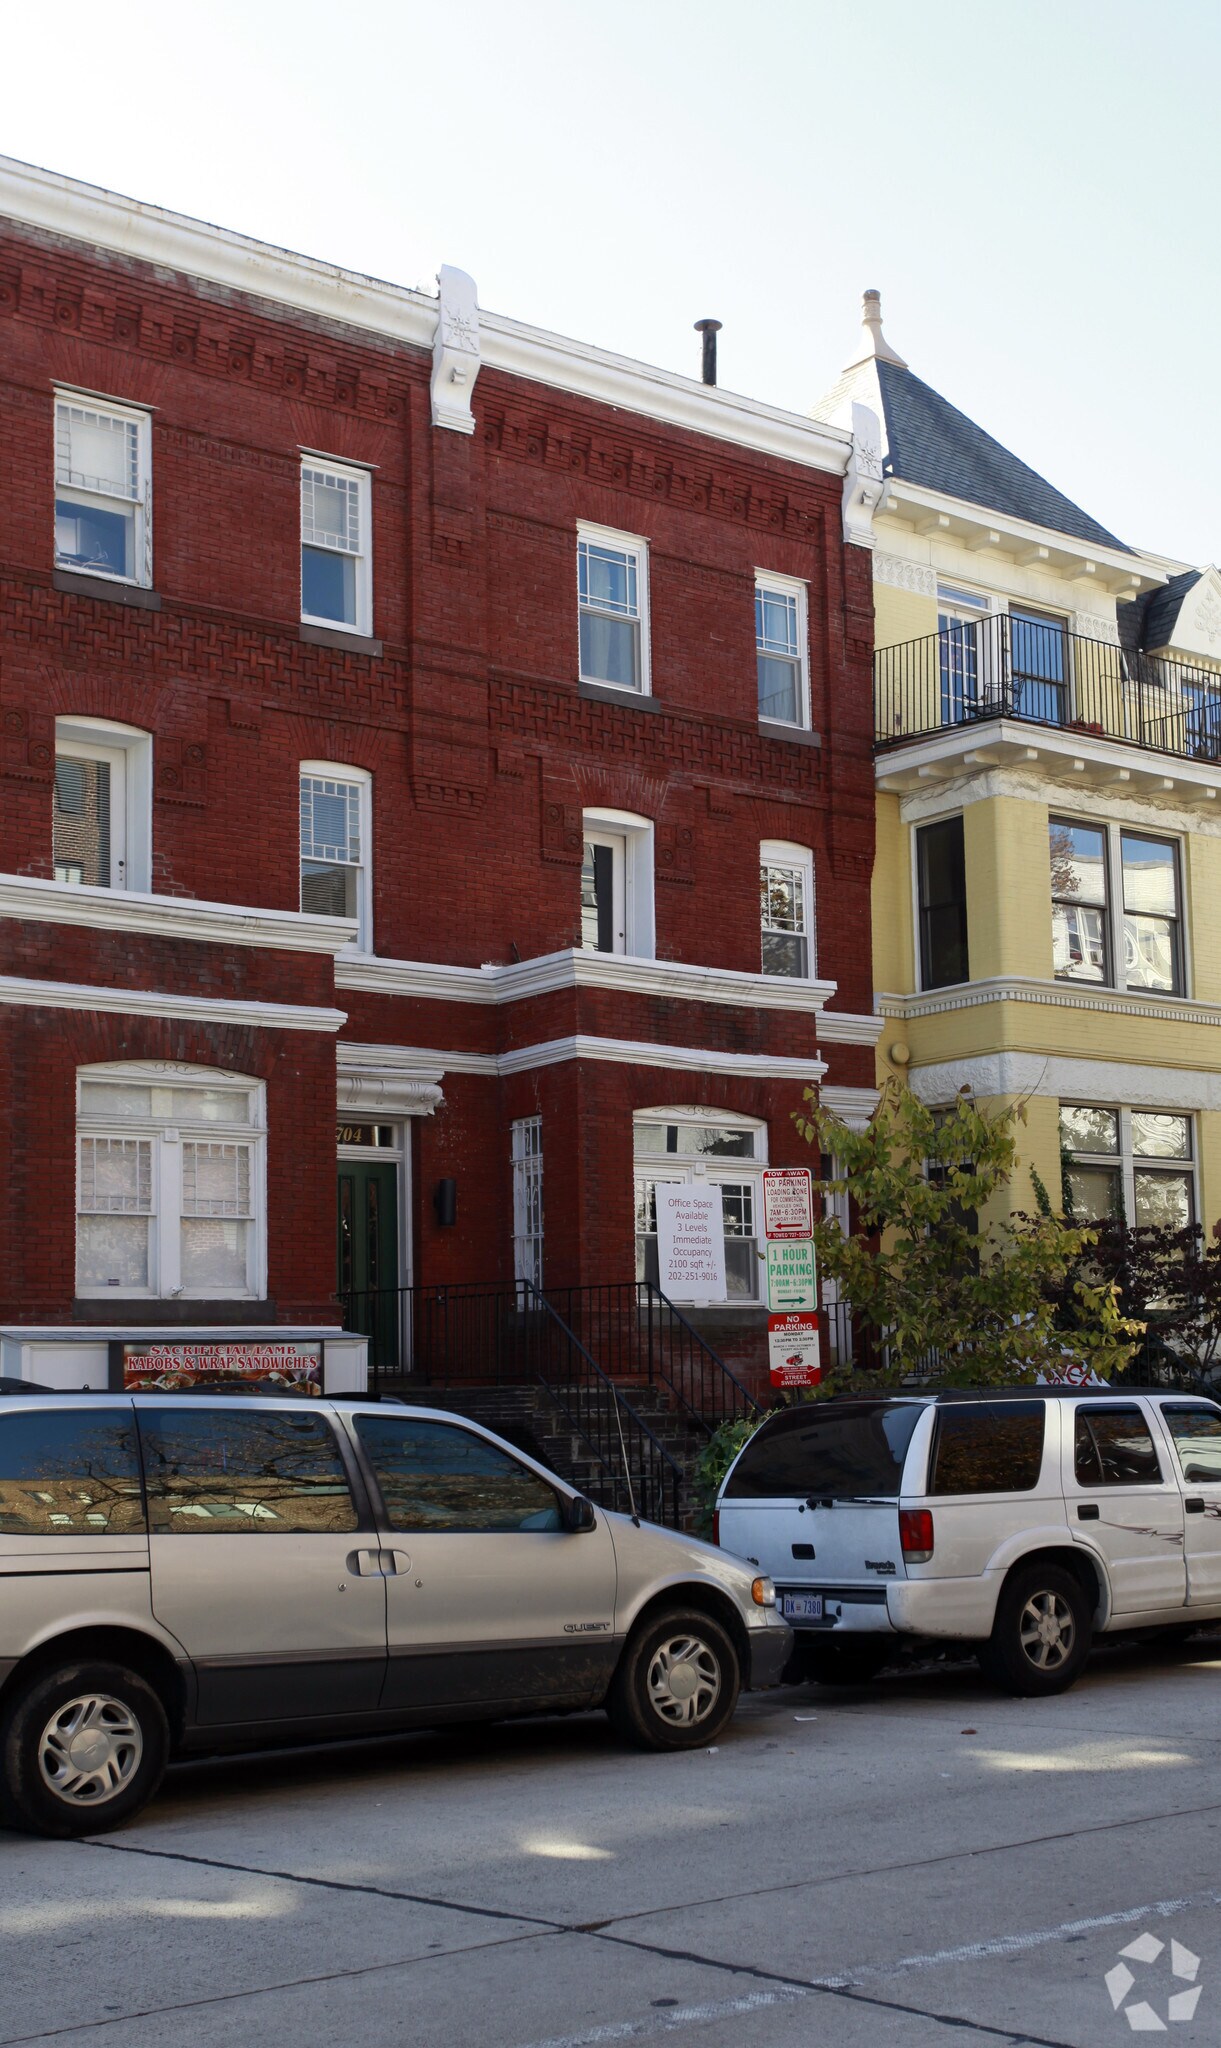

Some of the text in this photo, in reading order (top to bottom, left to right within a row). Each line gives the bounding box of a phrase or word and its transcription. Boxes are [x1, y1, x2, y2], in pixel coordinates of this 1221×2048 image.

[336, 1127, 362, 1142] 704
[779, 1179, 807, 1187] PARKING
[668, 1198, 713, 1209] Office Space
[675, 1211, 708, 1220] Available
[678, 1223, 708, 1232] 3 Levels
[673, 1235, 712, 1244] Immediate
[673, 1247, 712, 1257] Occupancy
[773, 1248, 807, 1261] 1 HOUR
[668, 1259, 688, 1268] 2100
[690, 1259, 704, 1270] sqft
[770, 1263, 812, 1275] PARKING
[668, 1271, 718, 1281] 202-251-9016
[786, 1315, 799, 1323] NO
[774, 1322, 813, 1331] PARKING
[151, 1345, 297, 1355] SACRIFICIAL LAMB
[127, 1355, 318, 1371] KABOBS & WRAP SANDWICHES
[563, 1622, 610, 1633] QUEST
